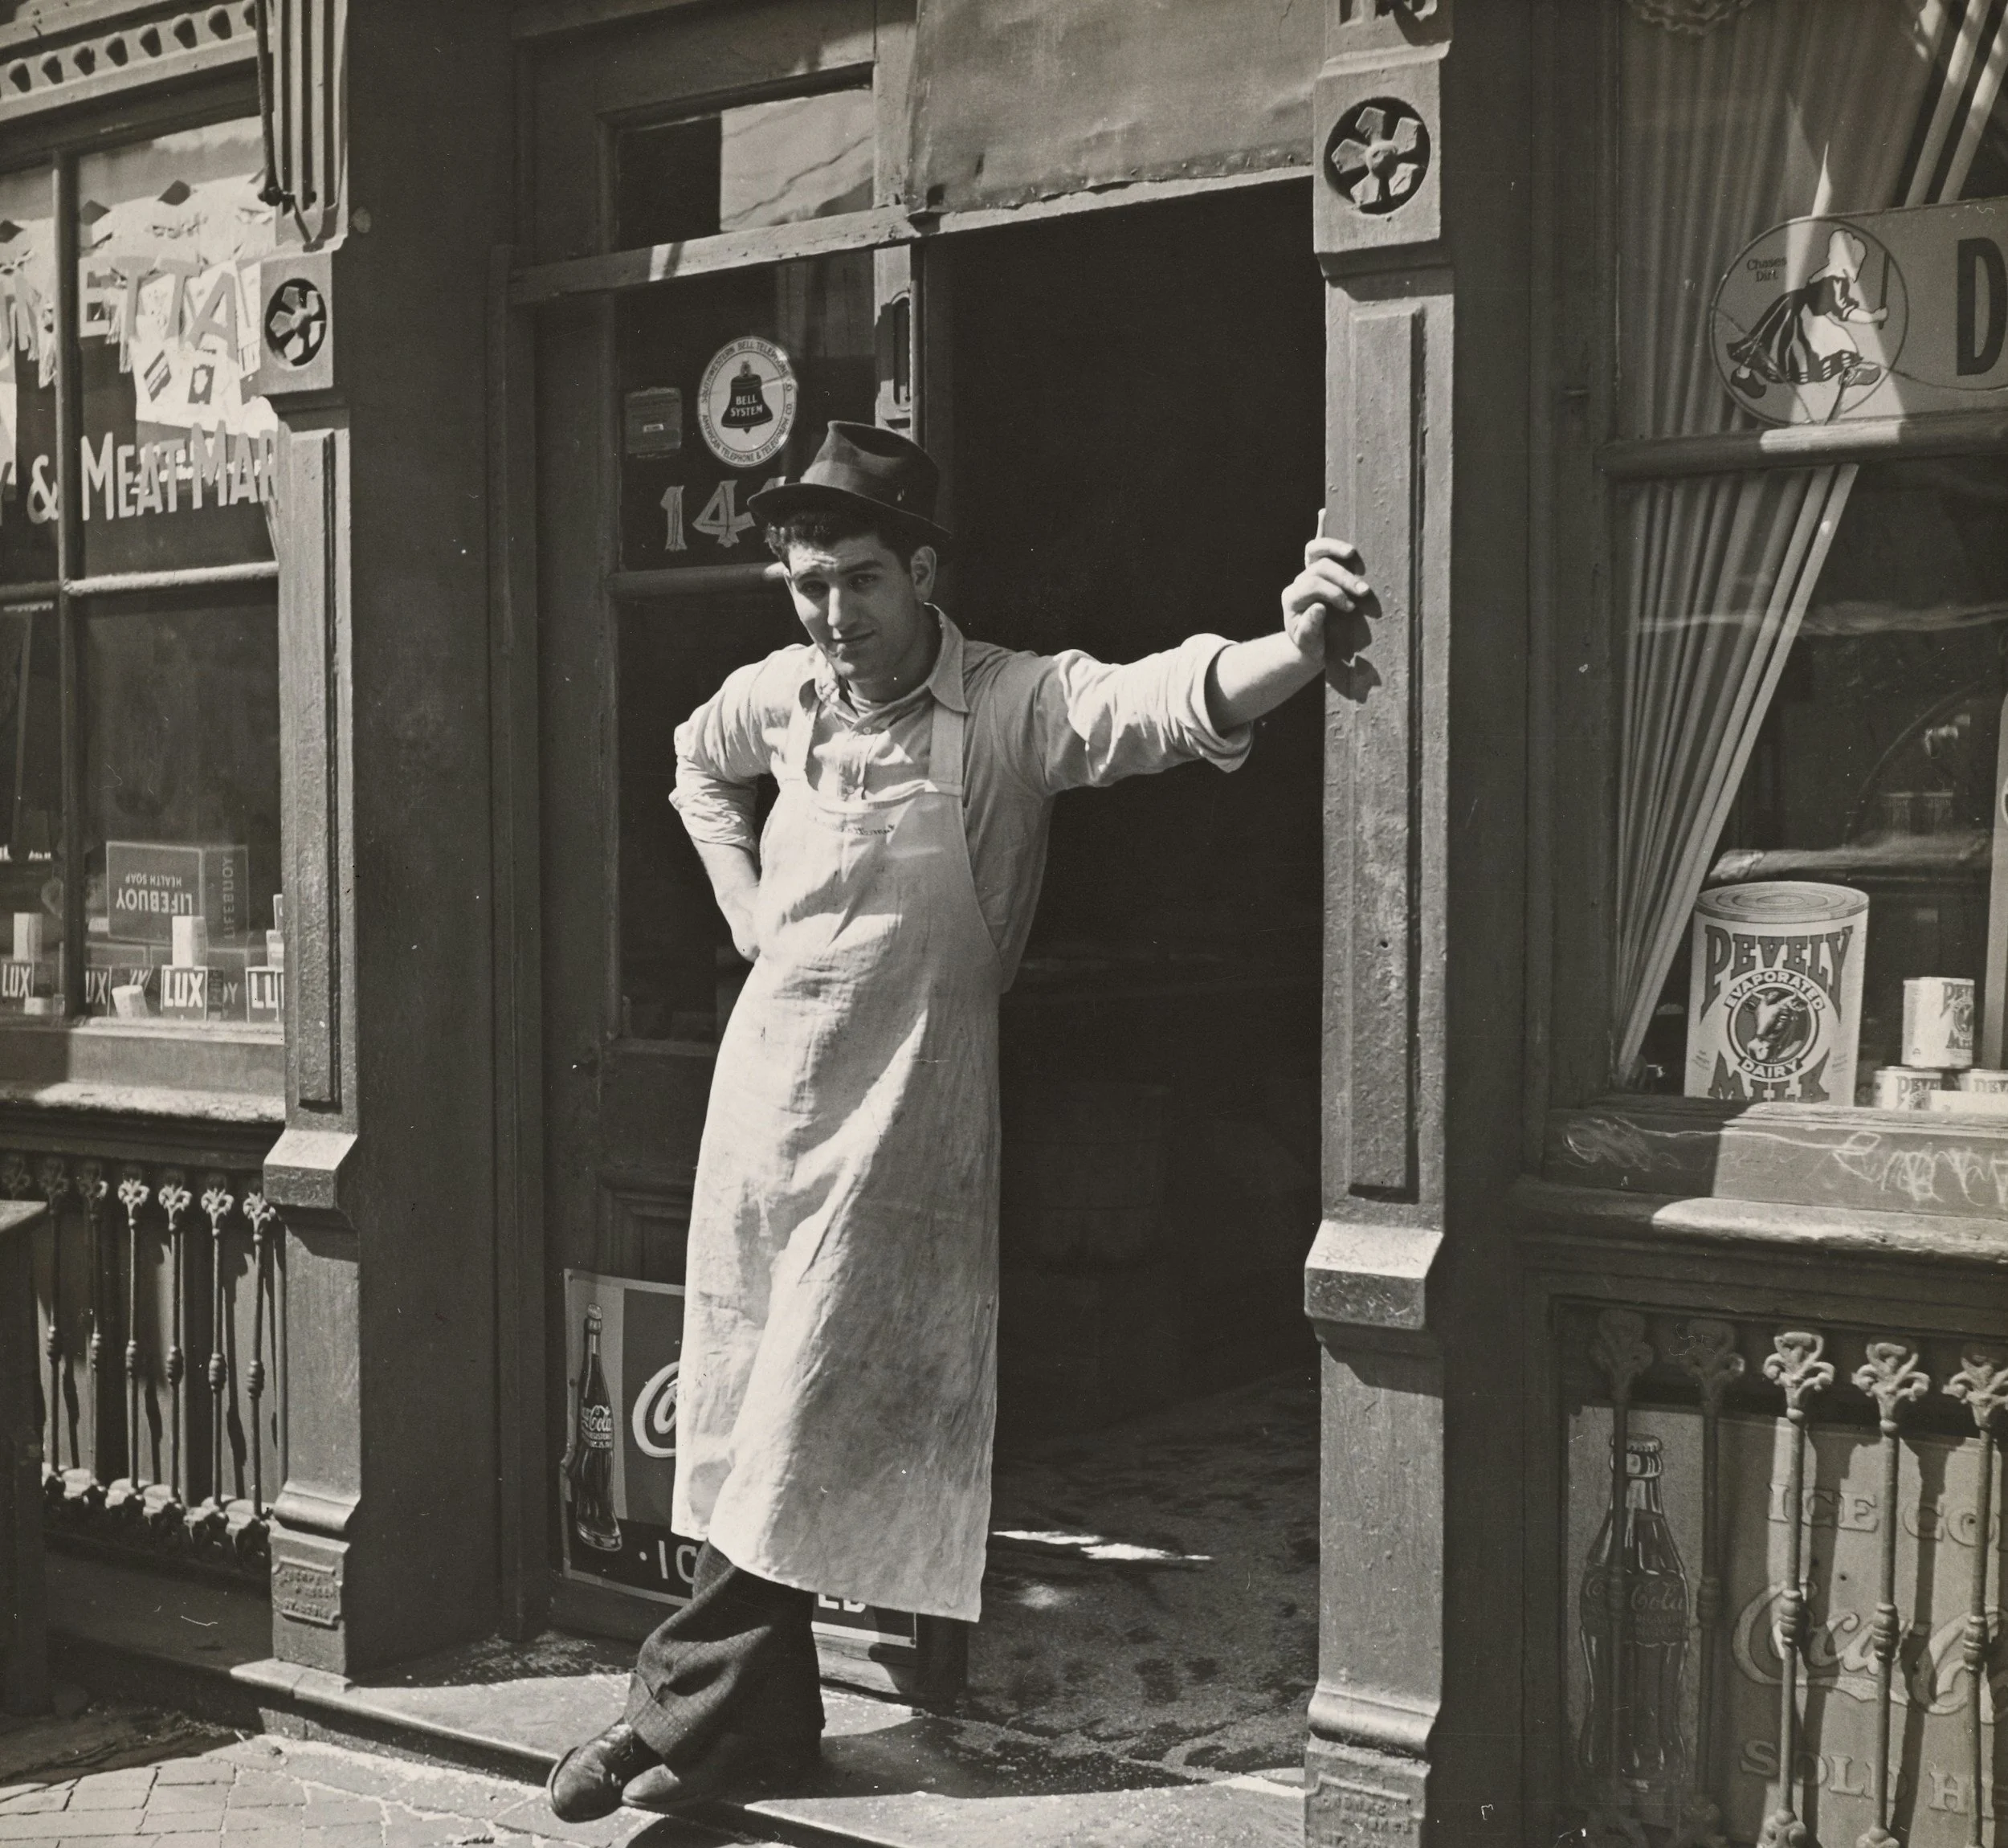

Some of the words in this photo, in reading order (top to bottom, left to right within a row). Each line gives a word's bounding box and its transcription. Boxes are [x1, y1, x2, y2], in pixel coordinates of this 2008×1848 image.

[737, 340, 755, 350] BELL
[730, 404, 763, 417] SYSTEM
[736, 394, 757, 406] BELL
[702, 414, 721, 450] AMERICAN
[721, 447, 754, 463] TELEPHONE
[27, 454, 59, 524] &
[81, 432, 186, 521] MEAT
[659, 476, 786, 551] 14
[124, 871, 148, 886] SOAP
[149, 875, 182, 887] HEALTH
[116, 887, 193, 915] LIFEBUOY
[2, 965, 31, 998] LUX
[85, 969, 108, 1006] UX
[163, 969, 204, 1009] LUX
[1700, 924, 1854, 1025] PEVELY
[1724, 969, 1826, 1012] EVAPORATED
[1708, 1047, 1831, 1104] MILK
[1738, 1059, 1804, 1080] DAIRY
[1766, 1482, 1879, 1532] ICE
